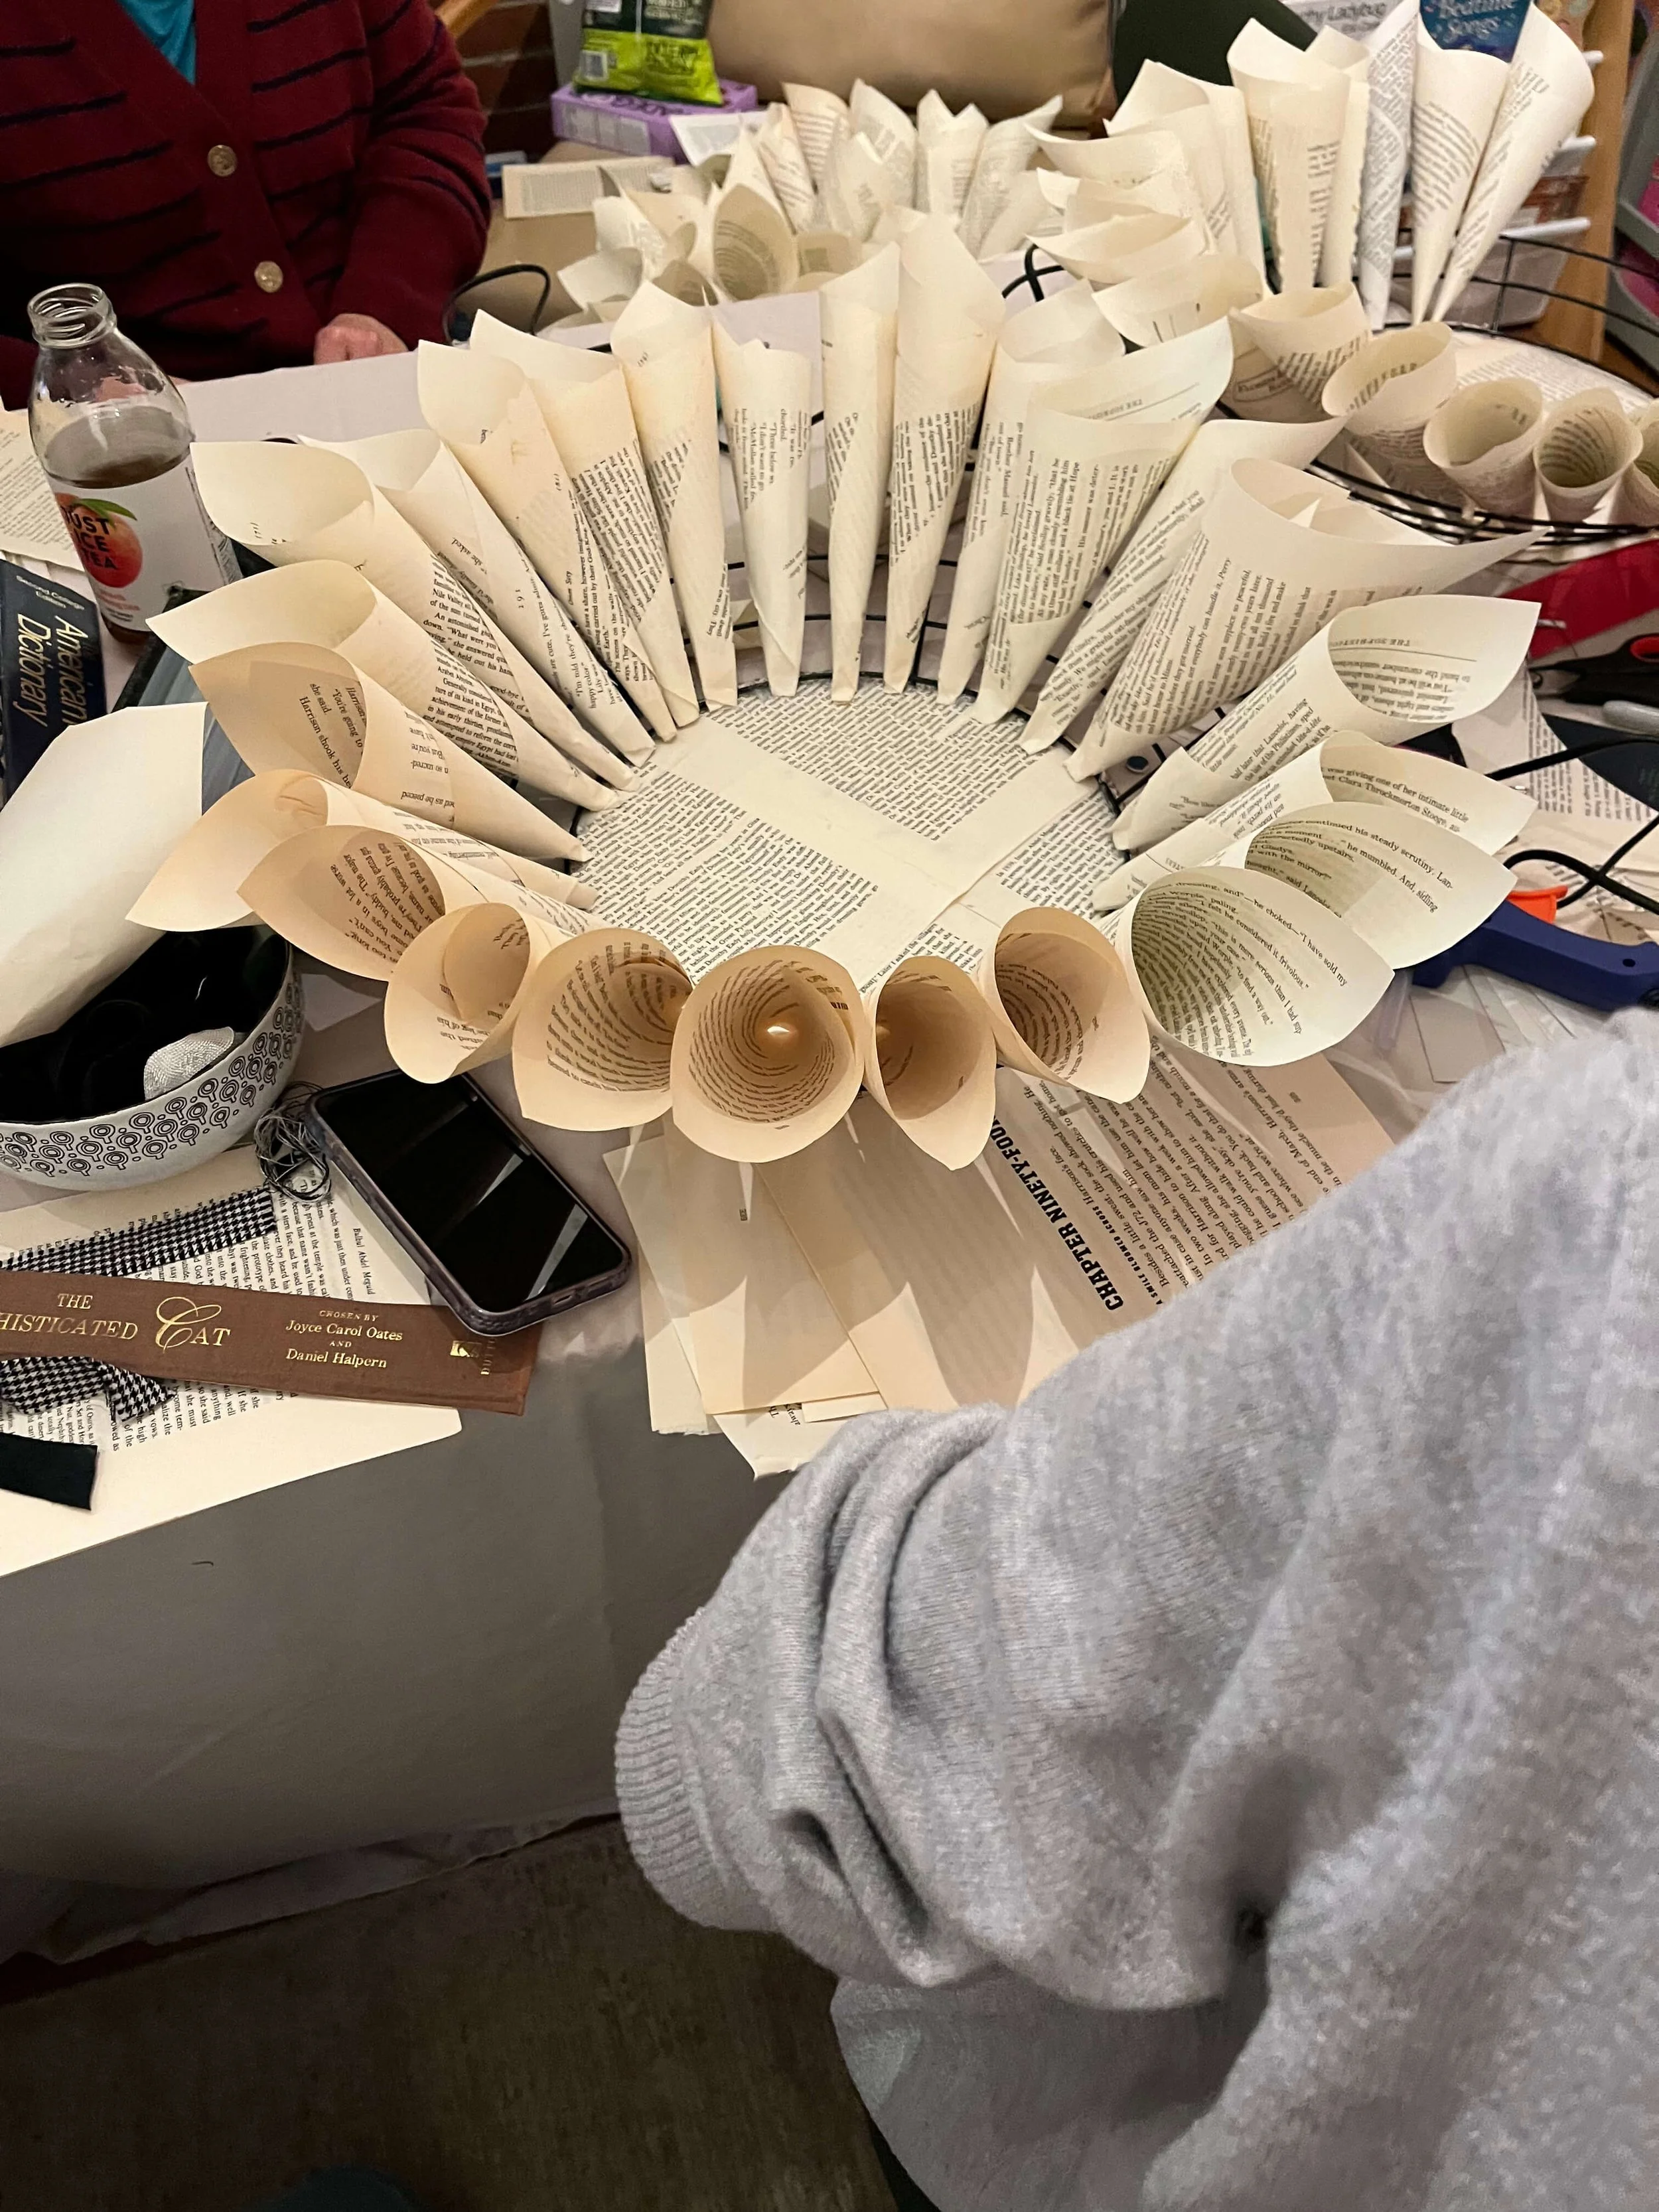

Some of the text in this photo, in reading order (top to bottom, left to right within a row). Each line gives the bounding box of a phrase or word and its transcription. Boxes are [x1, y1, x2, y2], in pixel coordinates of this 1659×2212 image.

[74, 529, 109, 552] ICE
[82, 547, 117, 571] TEA
[589, 581, 598, 591] by
[541, 623, 551, 637] I've
[457, 650, 472, 662] held
[565, 633, 582, 678] told they're
[13, 613, 51, 727] Dictionary
[54, 615, 90, 727] American
[309, 683, 321, 696] she
[587, 686, 601, 709] happy
[298, 696, 344, 775] Harrison shook his
[341, 715, 365, 748] going to
[1345, 769, 1375, 786] giving
[1417, 792, 1450, 814] intimate
[1354, 826, 1453, 889] his steady Lan-
[342, 853, 368, 892] The major
[1346, 842, 1358, 853] he
[1398, 874, 1416, 893] And,
[1415, 889, 1438, 913] sidling
[329, 863, 388, 936] boys in a lot worse
[376, 874, 401, 906] probably
[1235, 919, 1279, 959] considered it
[1307, 938, 1347, 987] have sold my
[1242, 976, 1255, 994] find
[1254, 960, 1299, 1021] serious than I had
[1023, 1086, 1036, 1099] He
[1052, 1103, 1068, 1116] get
[1063, 1116, 1073, 1127] to
[1052, 1130, 1080, 1159] showed
[1072, 1126, 1098, 1159] crutches
[1049, 1145, 1065, 1164] face.
[1193, 1143, 1220, 1173] without
[1076, 1159, 1094, 1178] sock
[1095, 1159, 1109, 1174] his
[1061, 1163, 1095, 1205] Harrison's
[1092, 1179, 1105, 1193] the
[1097, 1114, 1214, 1266] In two his mom let him use the
[1103, 1172, 1123, 1193] used
[1218, 1173, 1237, 1194] walk
[1103, 1193, 1125, 1220] sweat,
[1118, 1192, 1136, 1209] and
[1232, 1194, 1255, 1217] could
[303, 1212, 315, 1230] priest
[328, 1207, 340, 1226] which
[1091, 1205, 1116, 1234] ACROSS
[1131, 1209, 1149, 1226] J72
[1135, 1187, 1194, 1266] in case anyone saw
[1177, 1192, 1220, 1246] for Harrison
[1252, 1218, 1264, 1230] he
[291, 1200, 313, 1279] because that name wasn't
[311, 1238, 319, 1250] the
[1123, 1221, 1141, 1244] little
[1145, 1227, 1159, 1242] the
[281, 1214, 303, 1286] stern face, and he used
[332, 1239, 344, 1252] just
[1113, 1235, 1141, 1272] BLOOMED
[250, 1252, 263, 1283] prototype
[264, 1251, 279, 1290] clothes, and
[275, 1244, 291, 1290] they heard his
[313, 1250, 325, 1272] temple
[337, 1251, 346, 1267] then
[352, 1227, 376, 1295] Bulbul Abdel Meguid
[1057, 1221, 1123, 1311] CHAPTER
[1143, 1251, 1170, 1288] Besides
[340, 1266, 351, 1286] under
[1137, 1272, 1158, 1298] SMILE
[57, 1293, 94, 1310] THE
[319, 1310, 379, 1322] CHOSEN BY
[285, 1319, 403, 1341] Joyce Carol Oates
[285, 1348, 388, 1368] Daniel Halpern
[185, 1394, 197, 1428] she must
[198, 1394, 211, 1424] she said
[206, 1388, 222, 1421] anything
[226, 1400, 236, 1416] well
[238, 1399, 248, 1412] she
[149, 1417, 158, 1439] vows.
[175, 1413, 183, 1431] tem-
[123, 1423, 134, 1447] of the
[135, 1425, 147, 1443] high
